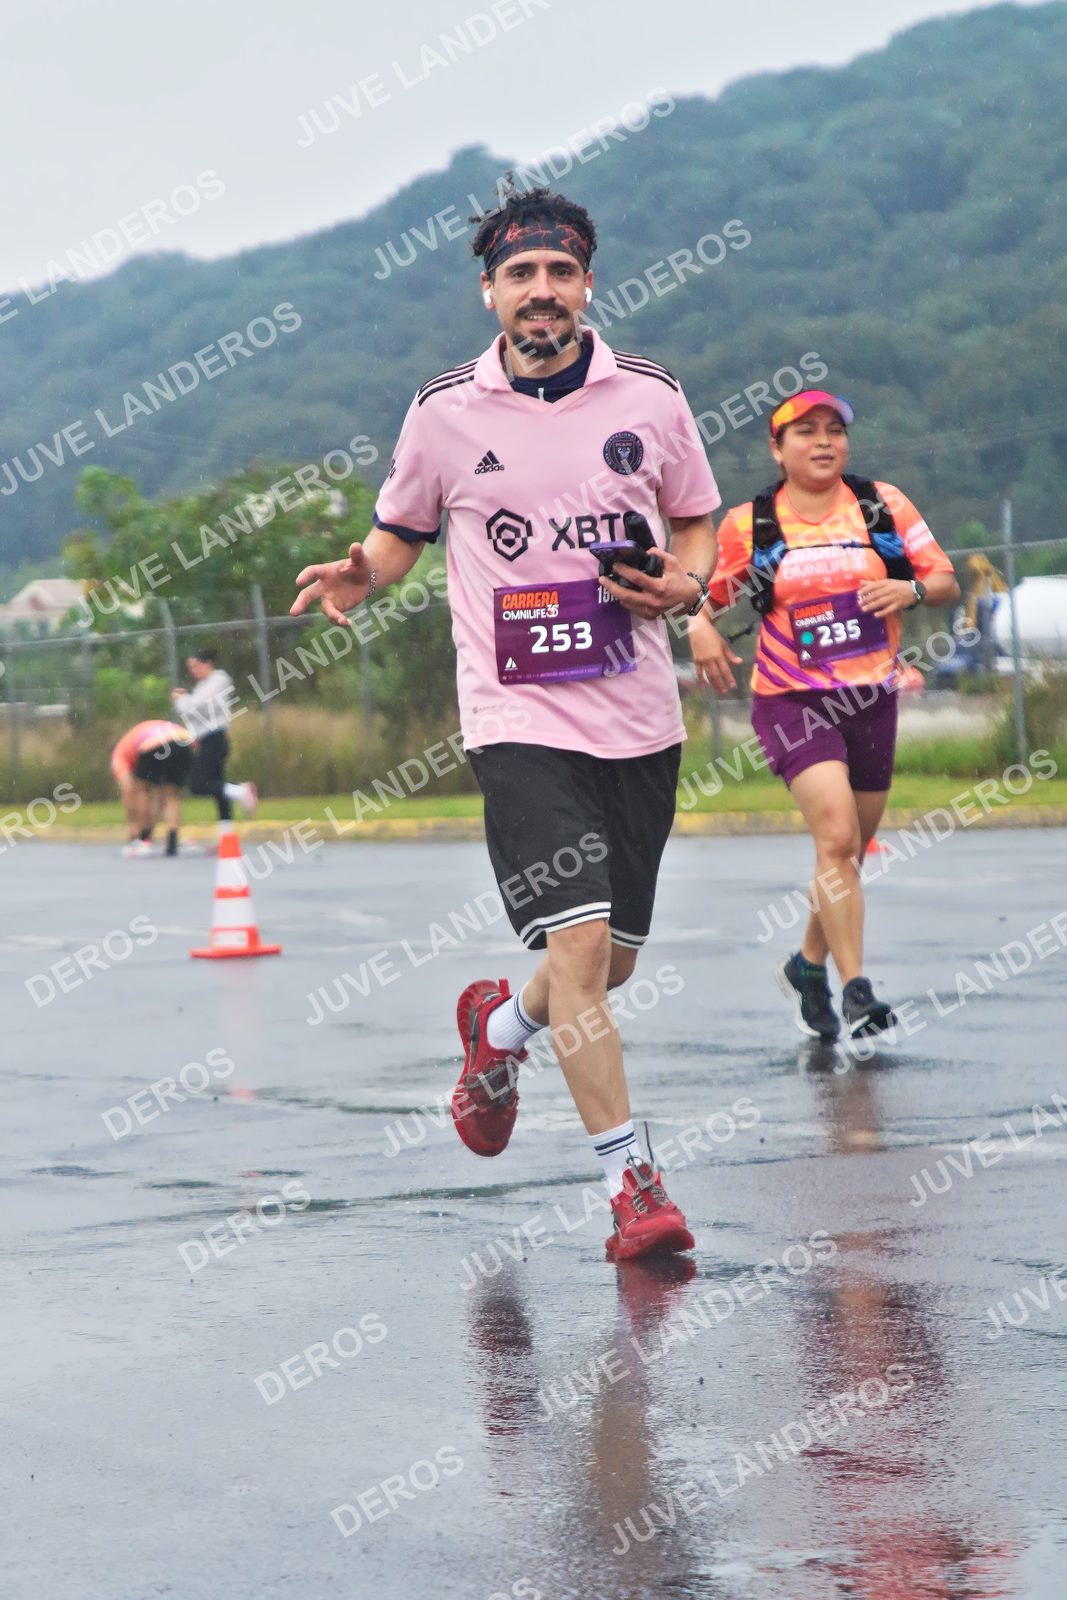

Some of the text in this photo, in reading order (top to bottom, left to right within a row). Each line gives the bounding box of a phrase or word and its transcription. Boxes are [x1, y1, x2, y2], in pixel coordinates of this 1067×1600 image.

[475, 464, 504, 474] adidas
[503, 591, 559, 609] CARRERA
[597, 585, 617, 604] 15
[530, 621, 593, 654] 253
[817, 619, 861, 647] 235
